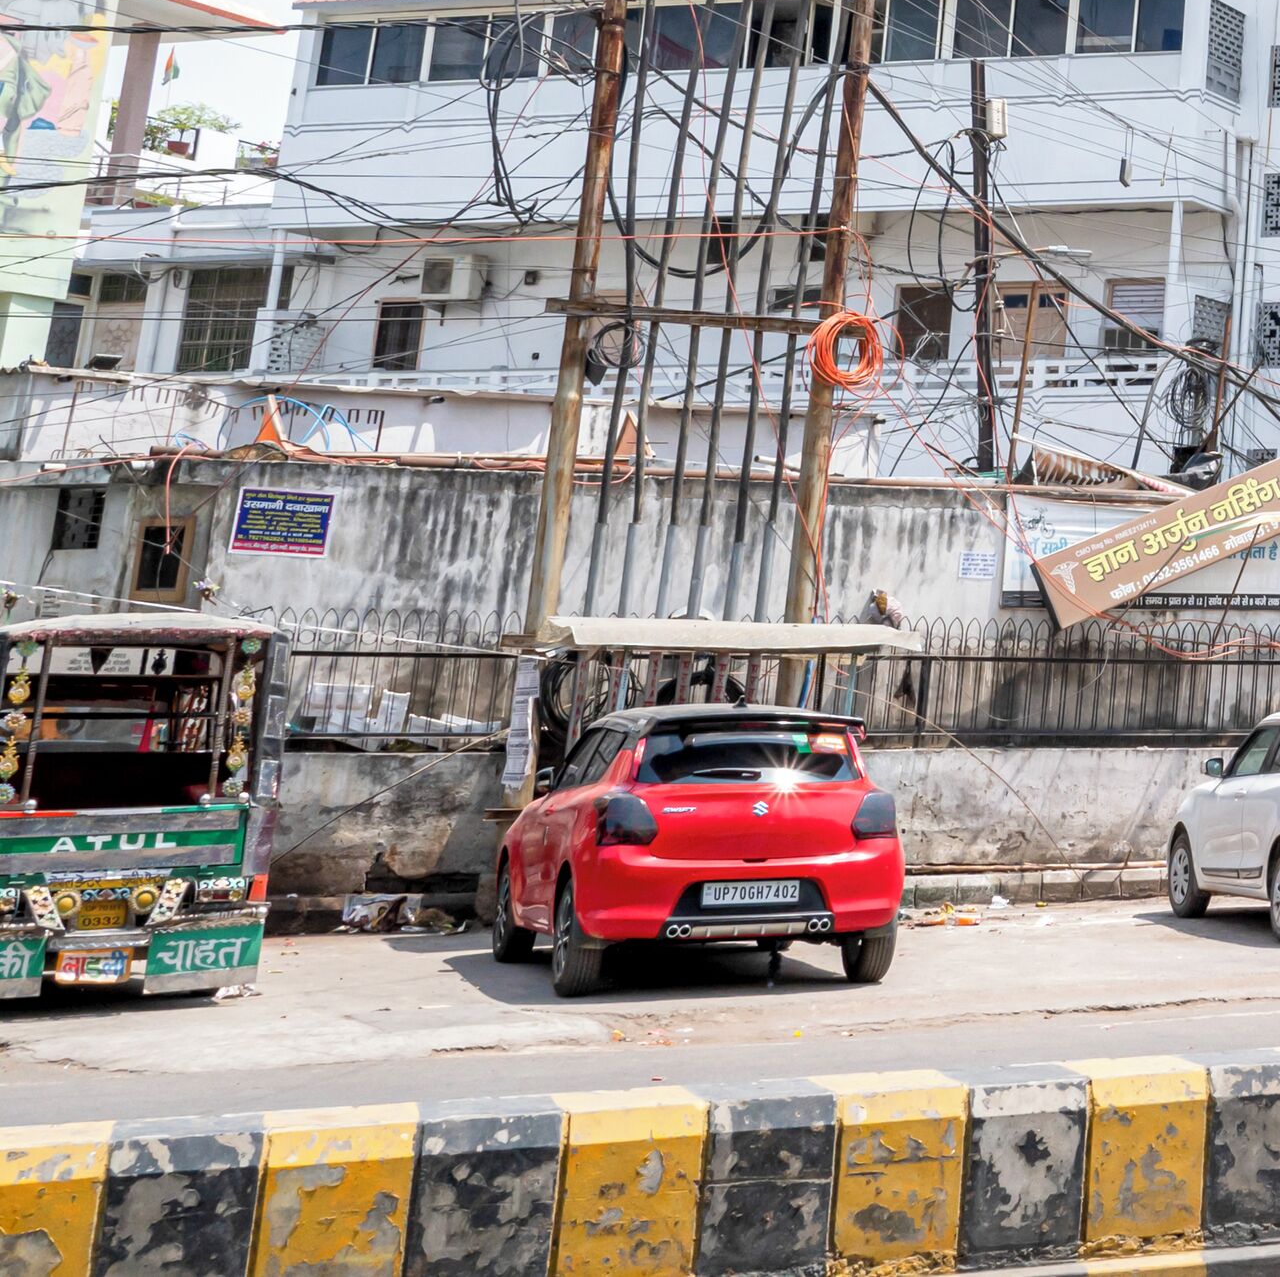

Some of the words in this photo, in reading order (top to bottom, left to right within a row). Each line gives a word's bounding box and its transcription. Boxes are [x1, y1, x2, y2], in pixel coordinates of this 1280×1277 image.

[1082, 539, 1140, 582] ज्ञान
[1141, 508, 1208, 552] अर्जुन
[661, 806, 697, 814] SWIFT
[50, 832, 178, 854] ATUL
[713, 884, 798, 901] UP70GH7402
[82, 915, 121, 927] 0332
[156, 936, 252, 971] चाहत
